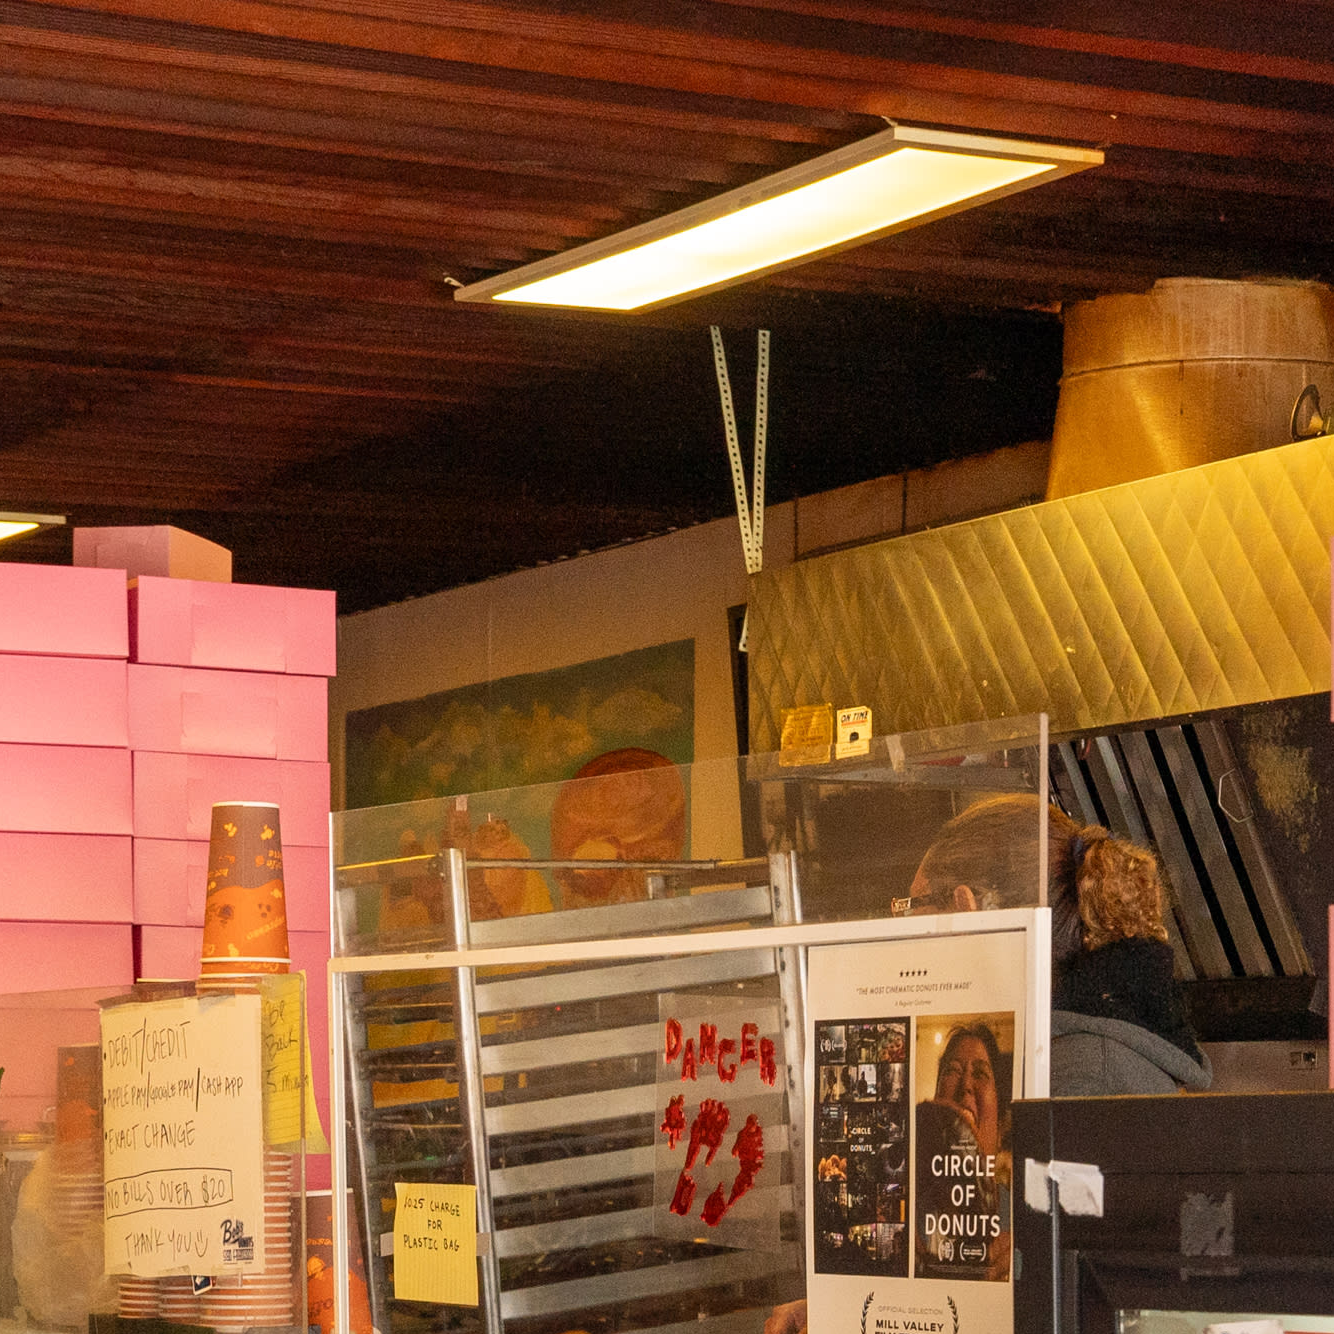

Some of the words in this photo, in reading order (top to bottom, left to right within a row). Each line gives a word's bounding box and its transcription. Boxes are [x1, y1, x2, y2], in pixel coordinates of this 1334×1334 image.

[885, 985, 915, 994] CINEMATIC
[916, 983, 938, 992] DONUTS
[665, 1017, 777, 1087] DANGER
[144, 1119, 196, 1149] CHANGE
[931, 1154, 995, 1177] CIRCLE
[123, 1180, 155, 1206] BILLS
[160, 1181, 193, 1207] OVER
[202, 1174, 225, 1205] $20
[951, 1184, 976, 1206] OF
[430, 1201, 461, 1217] CHARGE
[427, 1219, 443, 1231] FOR
[925, 1213, 1001, 1238] DONUTS
[125, 1227, 164, 1259] THANK
[168, 1228, 192, 1262] YOU
[403, 1234, 438, 1251] PLASTIC
[443, 1238, 460, 1252] BAG
[876, 1319, 899, 1329] MILL
[903, 1320, 944, 1332] VALLEY
